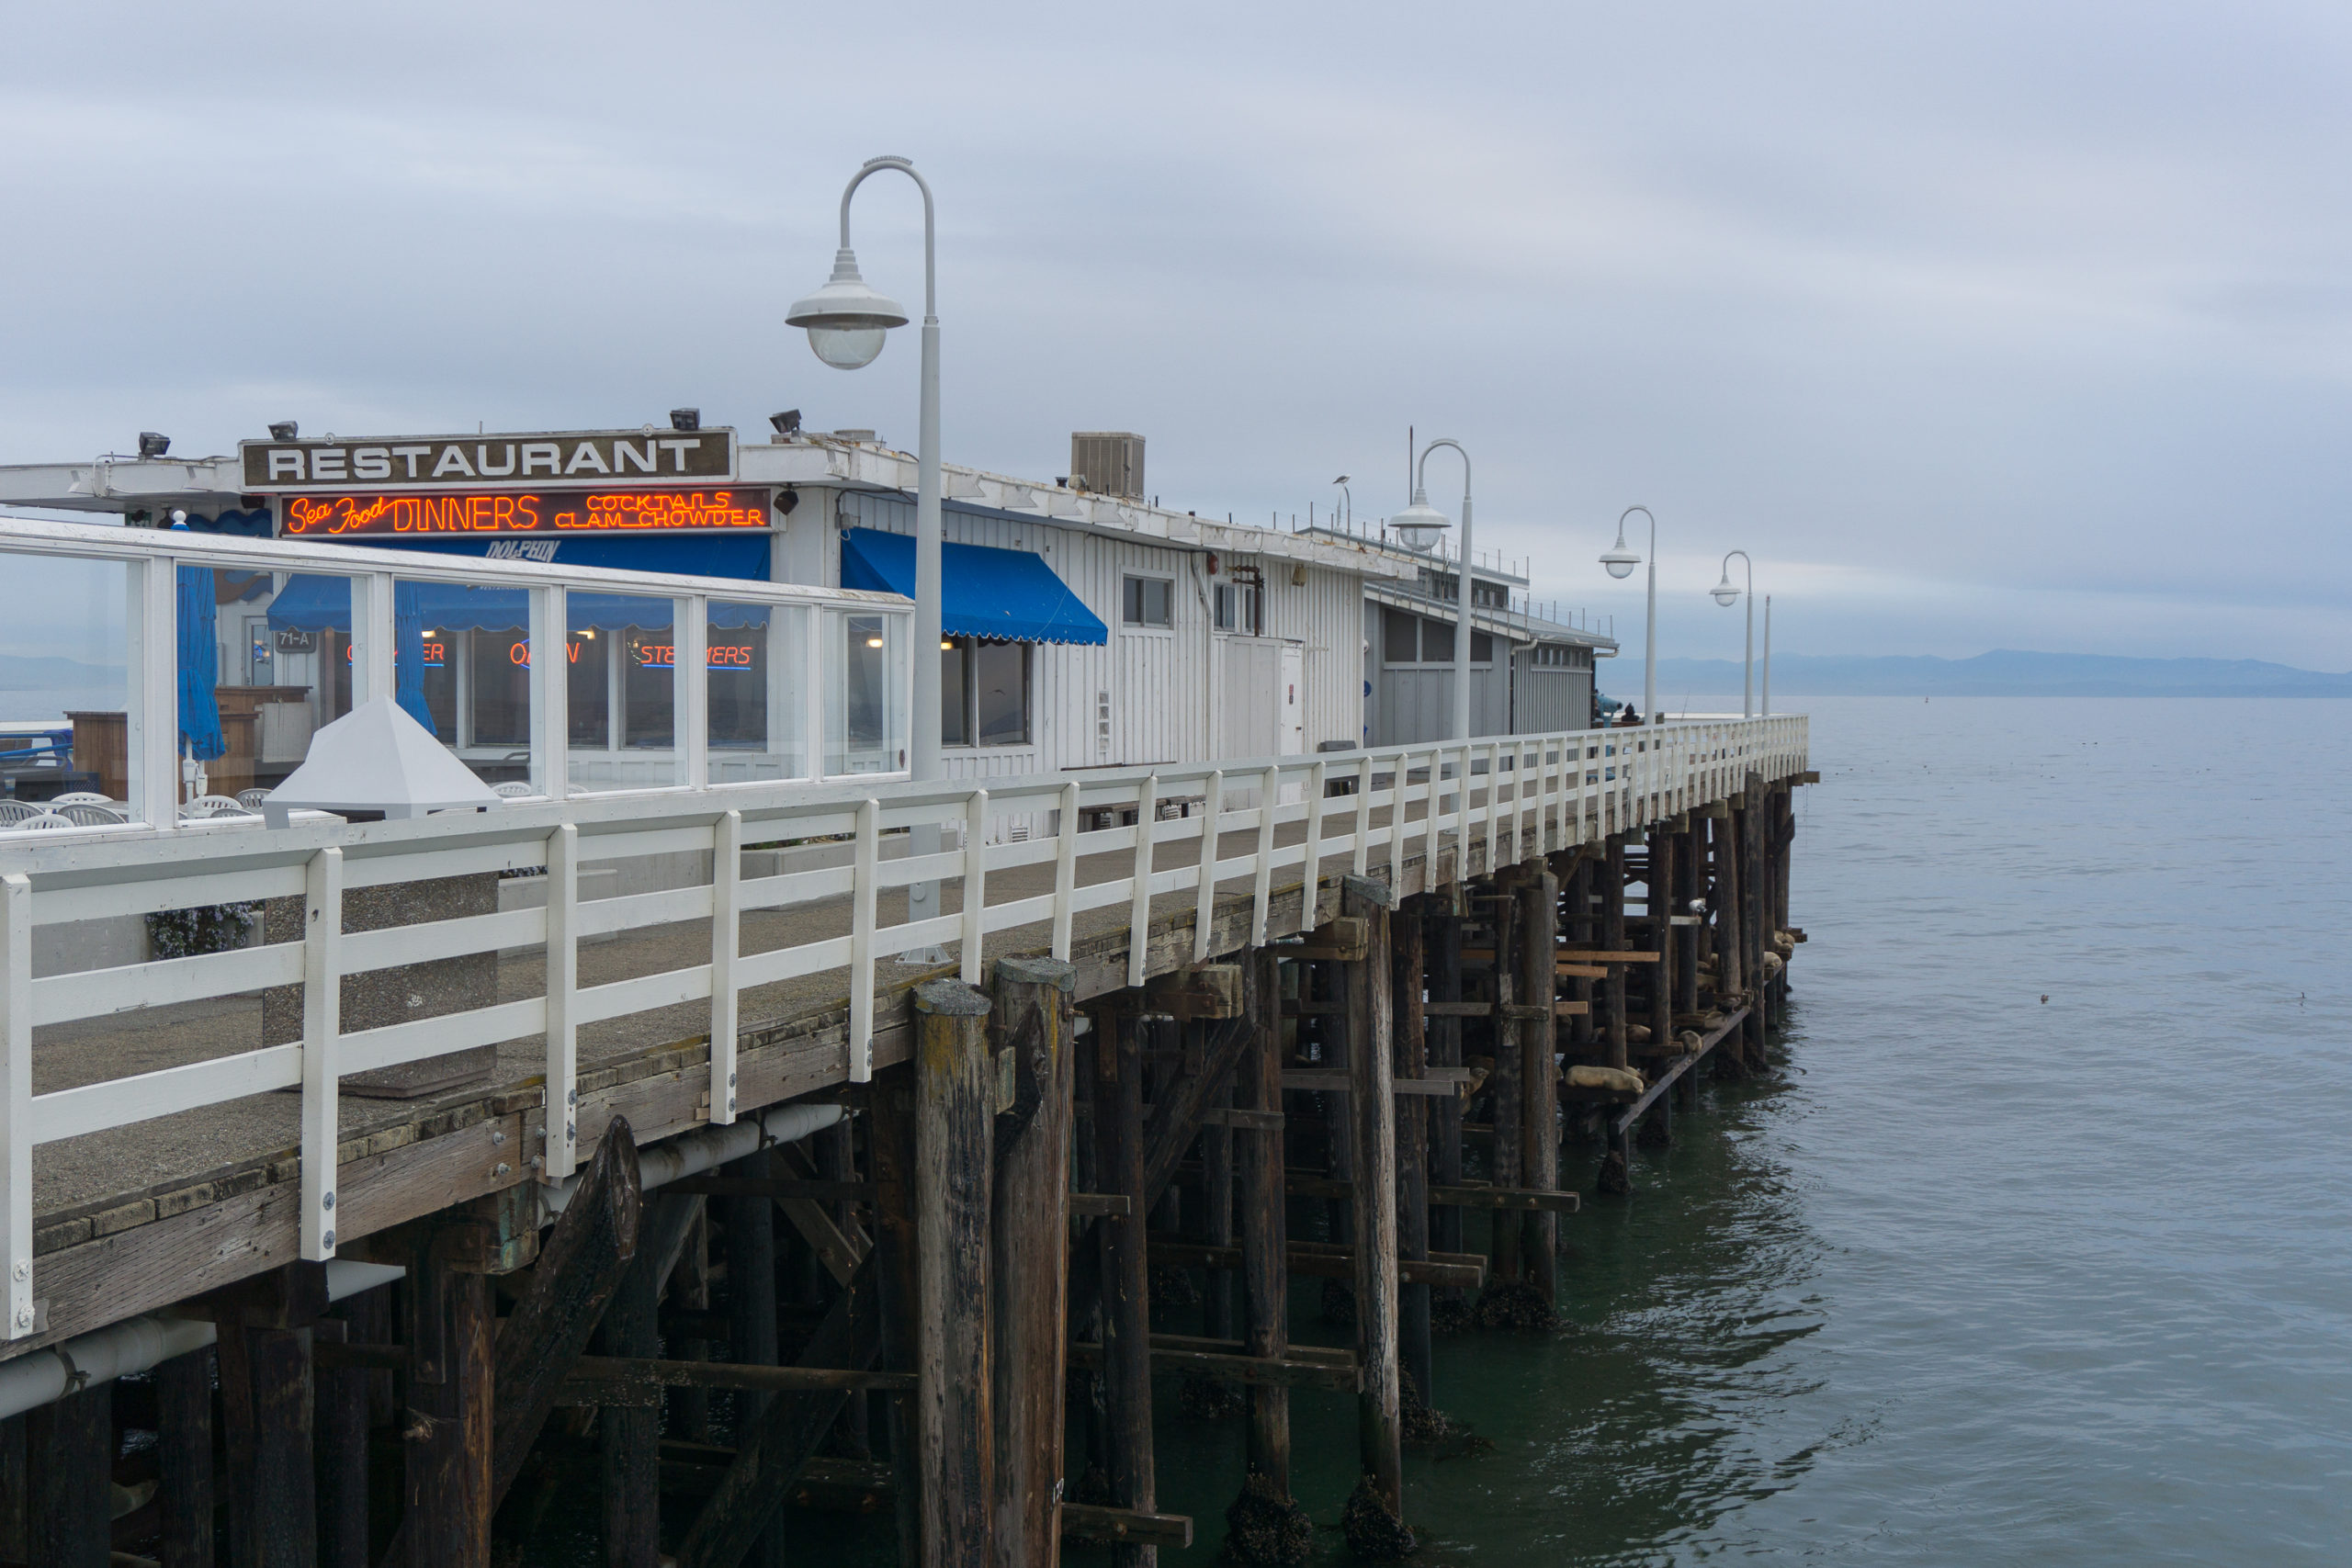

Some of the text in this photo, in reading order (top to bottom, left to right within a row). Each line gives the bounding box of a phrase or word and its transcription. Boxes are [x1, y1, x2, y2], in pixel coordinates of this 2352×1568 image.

[267, 438, 701, 480] RESTAURANT
[586, 491, 733, 511] COCKTAILS
[288, 495, 540, 534] Sea Food DINNERS
[554, 508, 765, 528] CLAM CHOWDER
[485, 539, 561, 563] DOLPHIN
[279, 632, 310, 646] 71-A
[639, 645, 753, 664] STEERS
